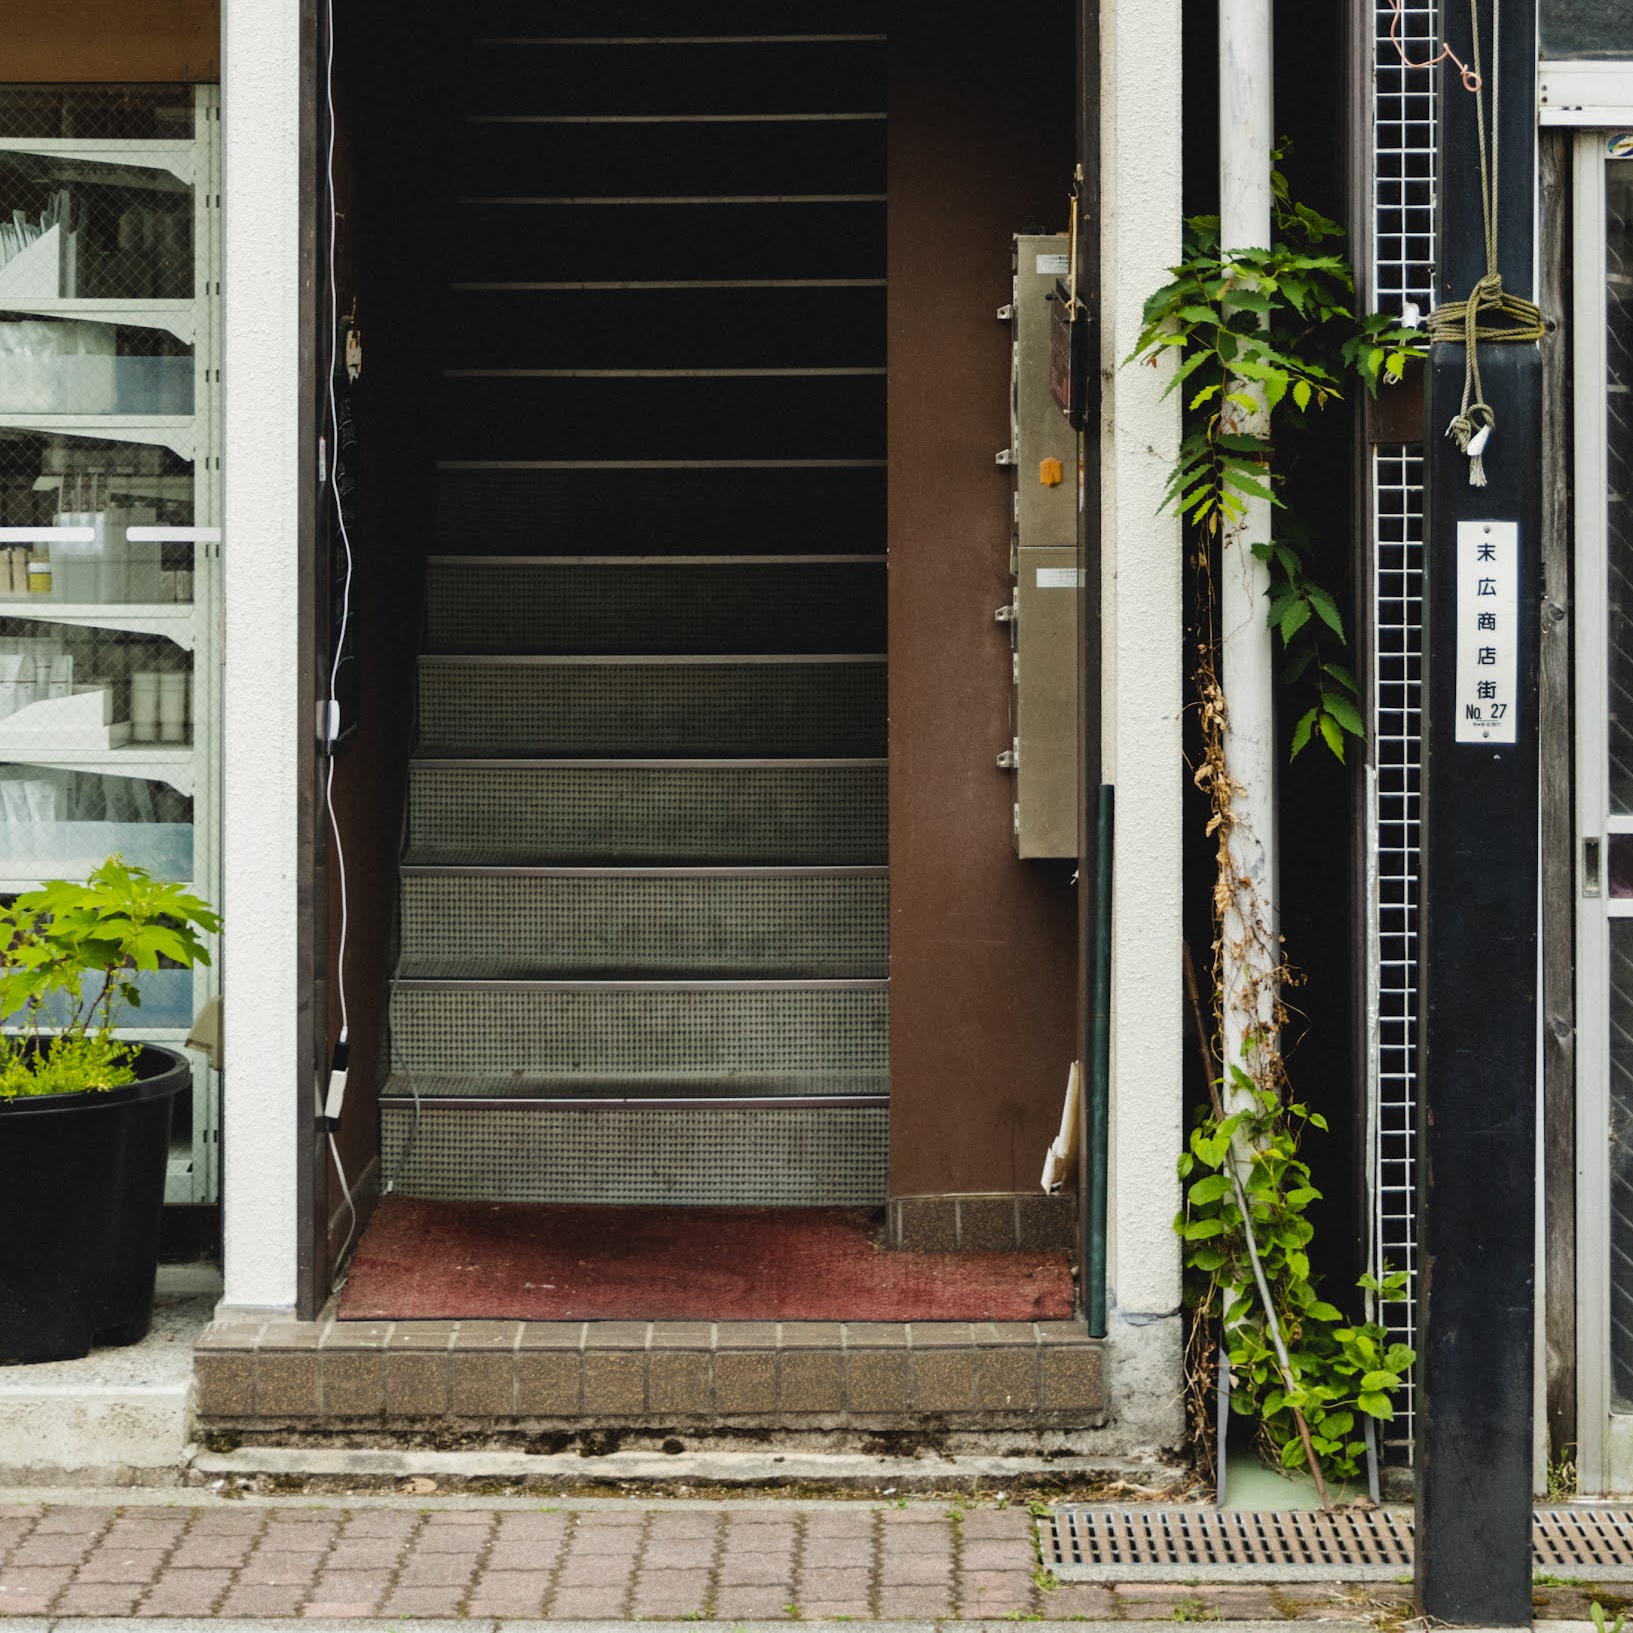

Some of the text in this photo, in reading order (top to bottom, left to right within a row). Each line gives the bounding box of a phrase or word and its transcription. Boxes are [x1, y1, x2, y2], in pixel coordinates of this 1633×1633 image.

[1476, 542, 1497, 701] 末広商店街
[1466, 703, 1508, 720] No. 27
